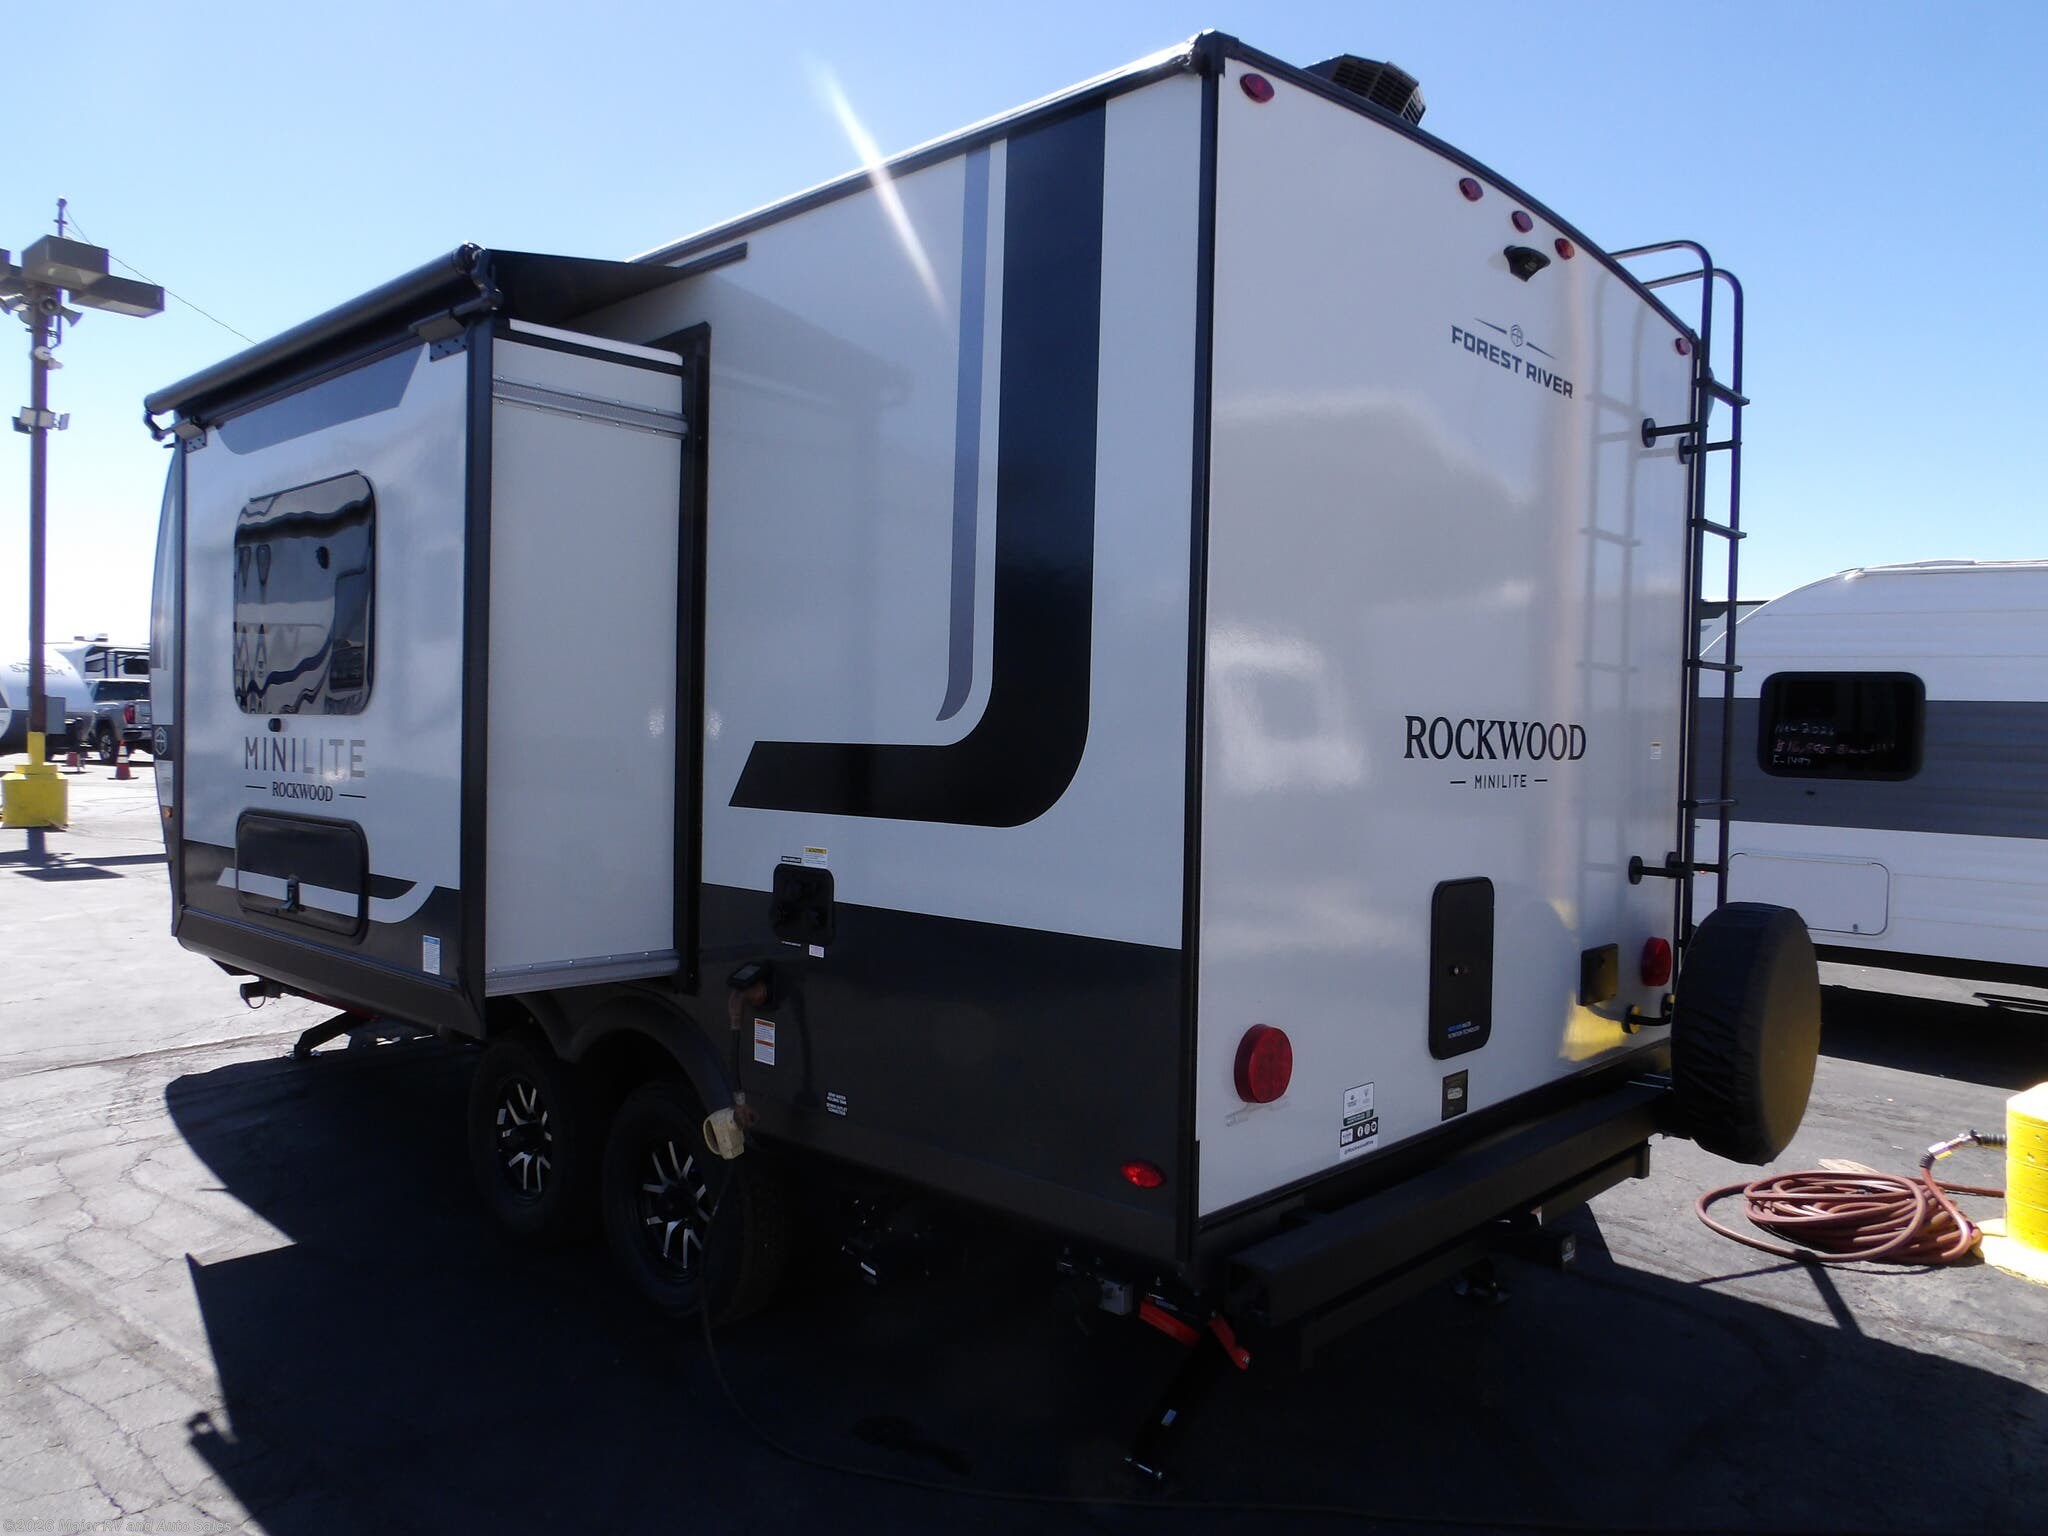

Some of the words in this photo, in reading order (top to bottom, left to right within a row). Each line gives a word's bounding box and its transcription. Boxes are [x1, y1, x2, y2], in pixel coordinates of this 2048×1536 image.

[1451, 325, 1522, 374] FOREST
[1526, 361, 1573, 399] RIVER
[8, 663, 66, 677] SAEM
[1403, 715, 1587, 761] ROCKWOOD
[244, 736, 366, 778] MINILITE
[271, 781, 334, 802] ROCKWOOD
[1474, 774, 1527, 789] MINILITE
